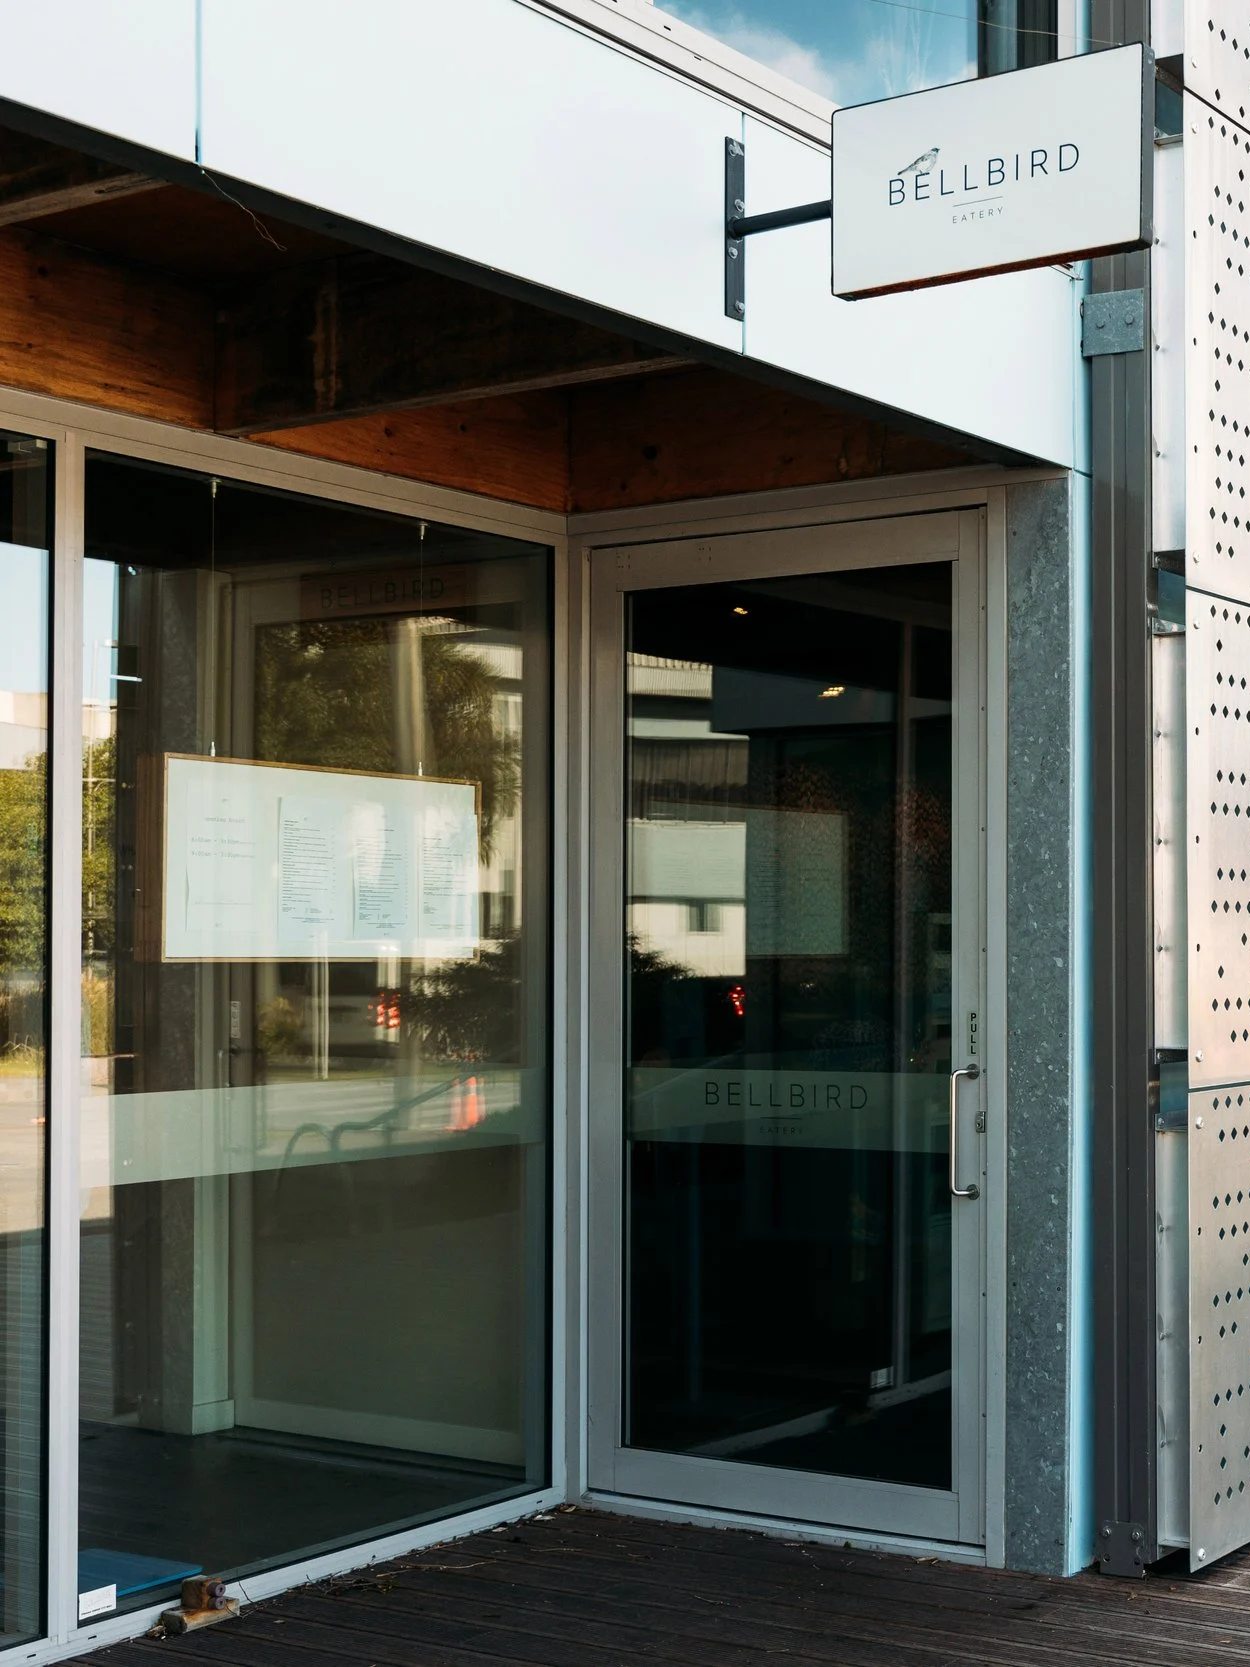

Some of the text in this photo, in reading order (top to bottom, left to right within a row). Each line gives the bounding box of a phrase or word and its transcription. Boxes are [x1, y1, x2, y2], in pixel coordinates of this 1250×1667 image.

[888, 143, 1080, 206] BELLBIRD
[952, 205, 1003, 224] EATERY
[320, 577, 445, 609] BELLBIRD
[705, 1081, 868, 1110] BELLBIRD
[759, 1126, 803, 1136] EATERY
